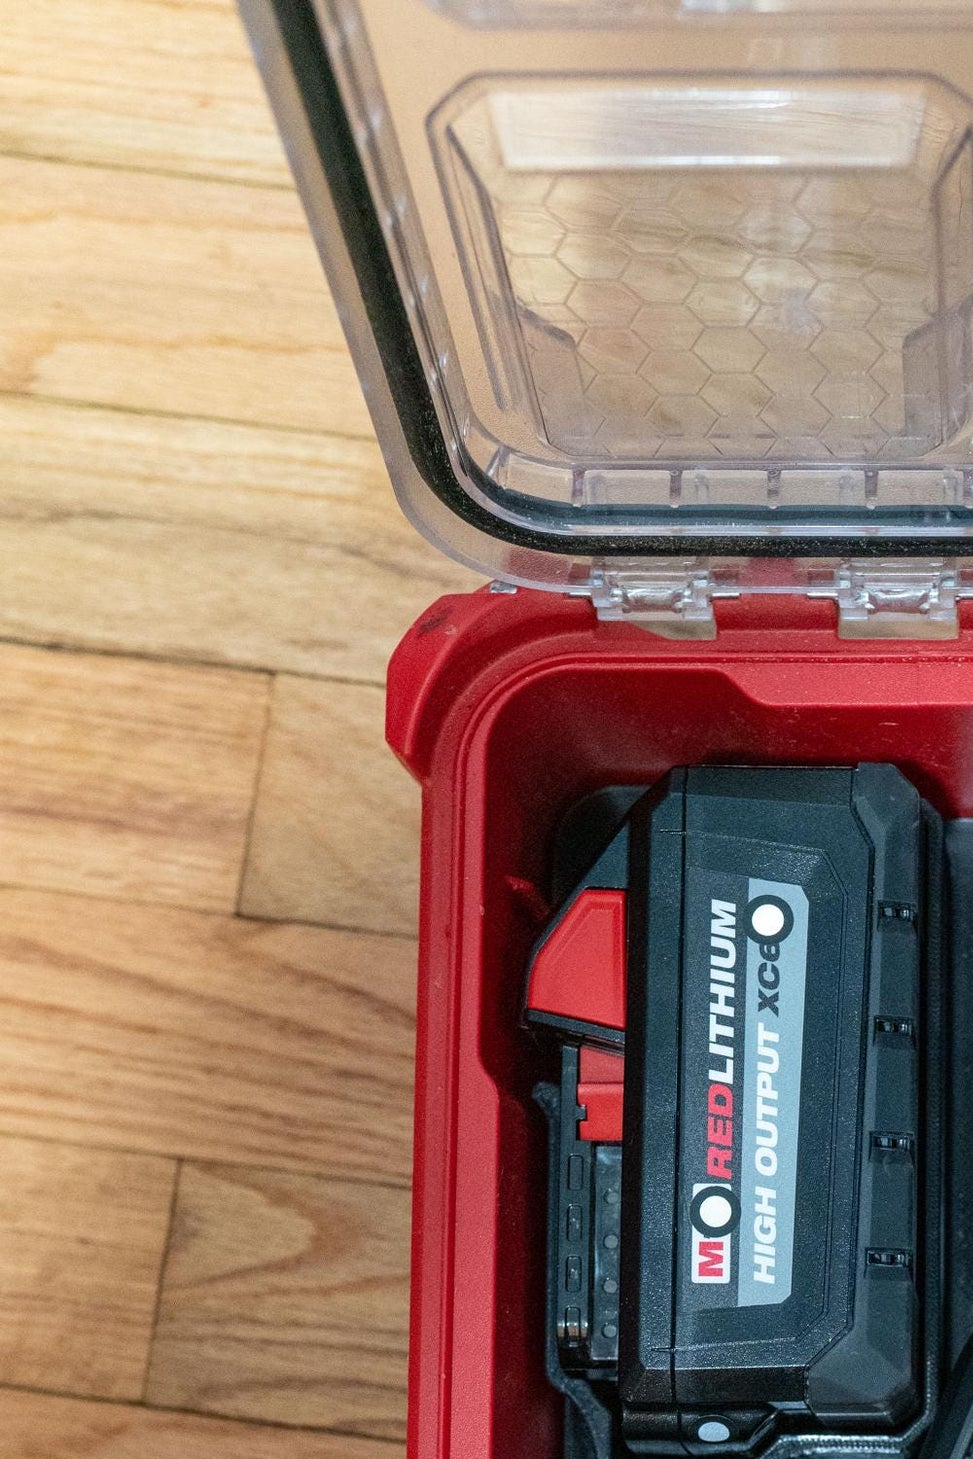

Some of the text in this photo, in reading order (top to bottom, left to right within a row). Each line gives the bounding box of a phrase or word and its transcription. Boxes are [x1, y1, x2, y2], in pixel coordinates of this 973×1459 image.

[706, 899, 738, 1179] REDLITHIUM
[753, 1022, 784, 1177] OUTPUT
[752, 1187, 778, 1285] HIGH
